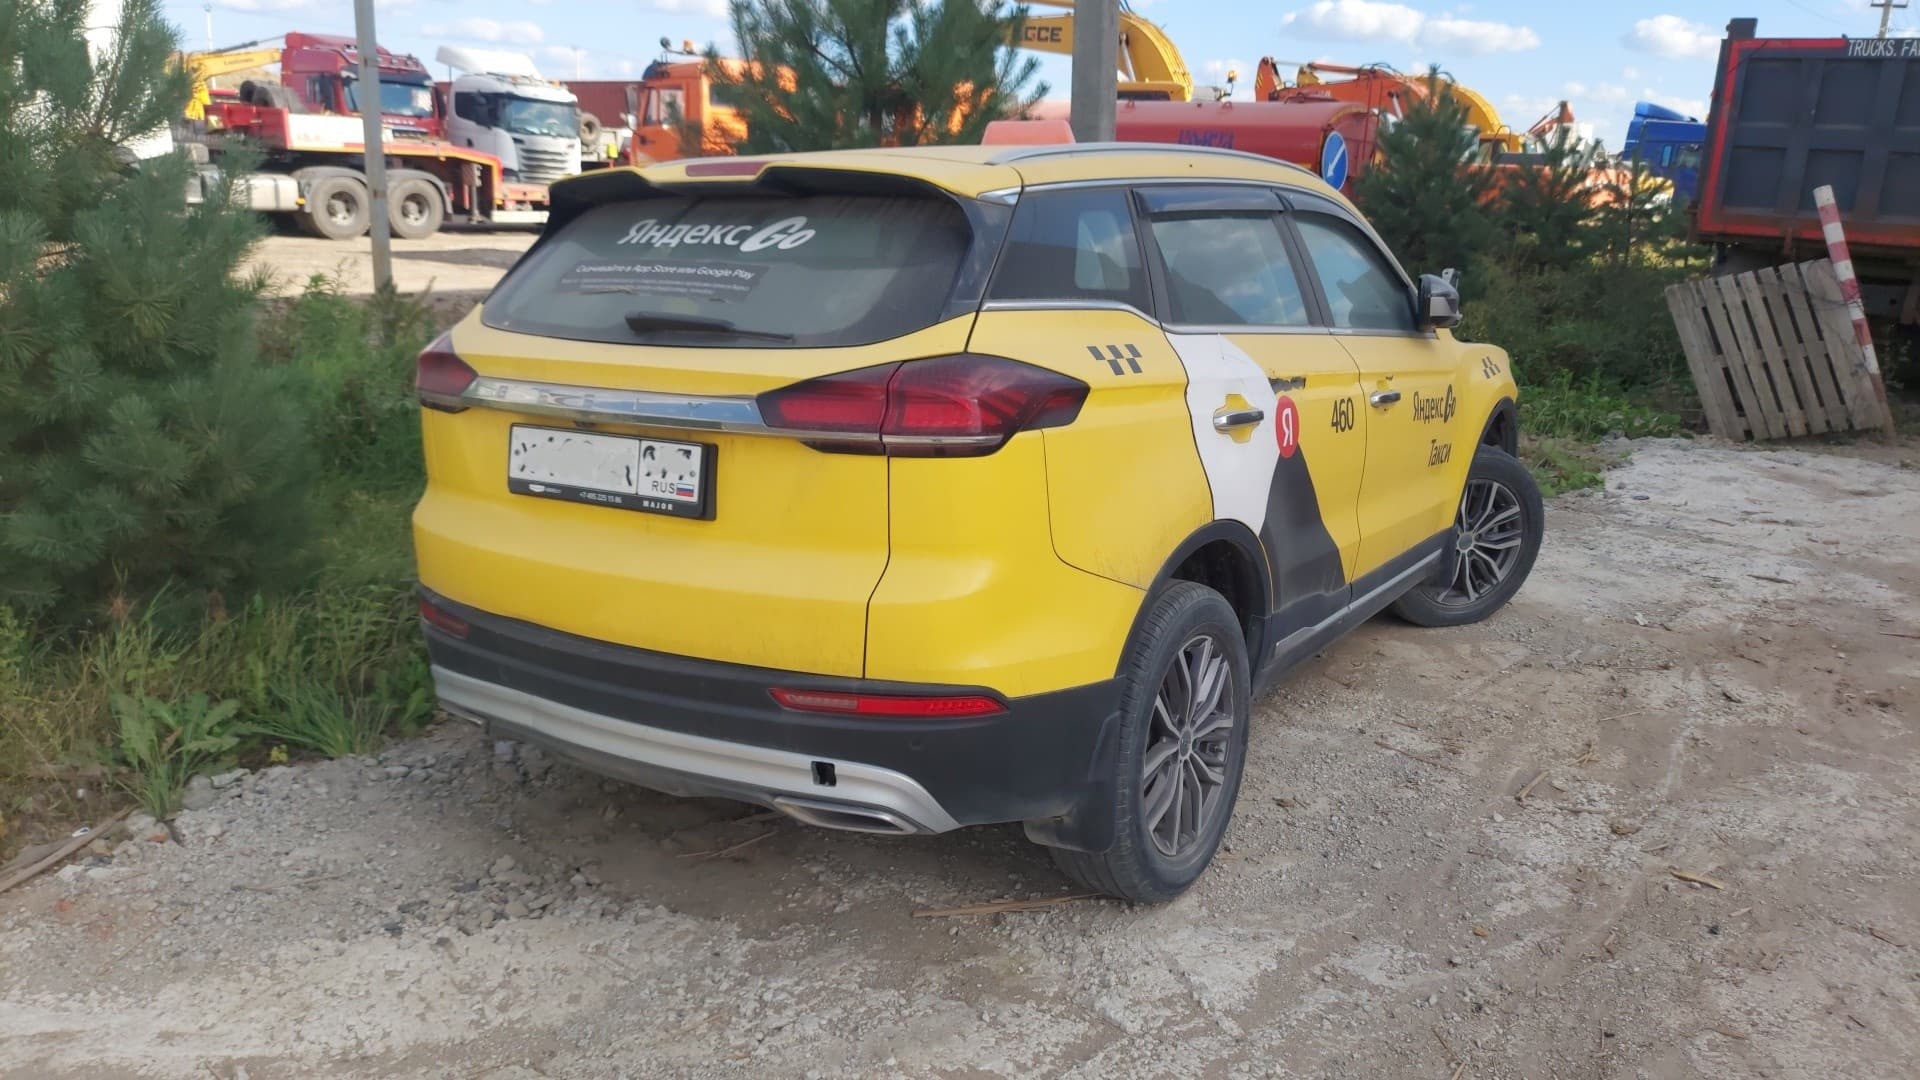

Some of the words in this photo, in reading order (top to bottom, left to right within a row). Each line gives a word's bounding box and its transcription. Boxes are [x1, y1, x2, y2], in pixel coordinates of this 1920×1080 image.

[1848, 39, 1897, 57] TRUCKS.
[1901, 39, 1920, 57] FA
[617, 218, 753, 247] Яндекс
[632, 265, 650, 274] App
[651, 264, 677, 273] Store
[697, 266, 732, 278] Google
[732, 269, 755, 280] Play
[1331, 397, 1355, 433] 460
[1412, 391, 1445, 424] Яндекс
[1282, 408, 1293, 447] Я
[1428, 438, 1452, 467] Такси
[651, 480, 675, 494] RUS
[642, 500, 673, 511] MAJOR
